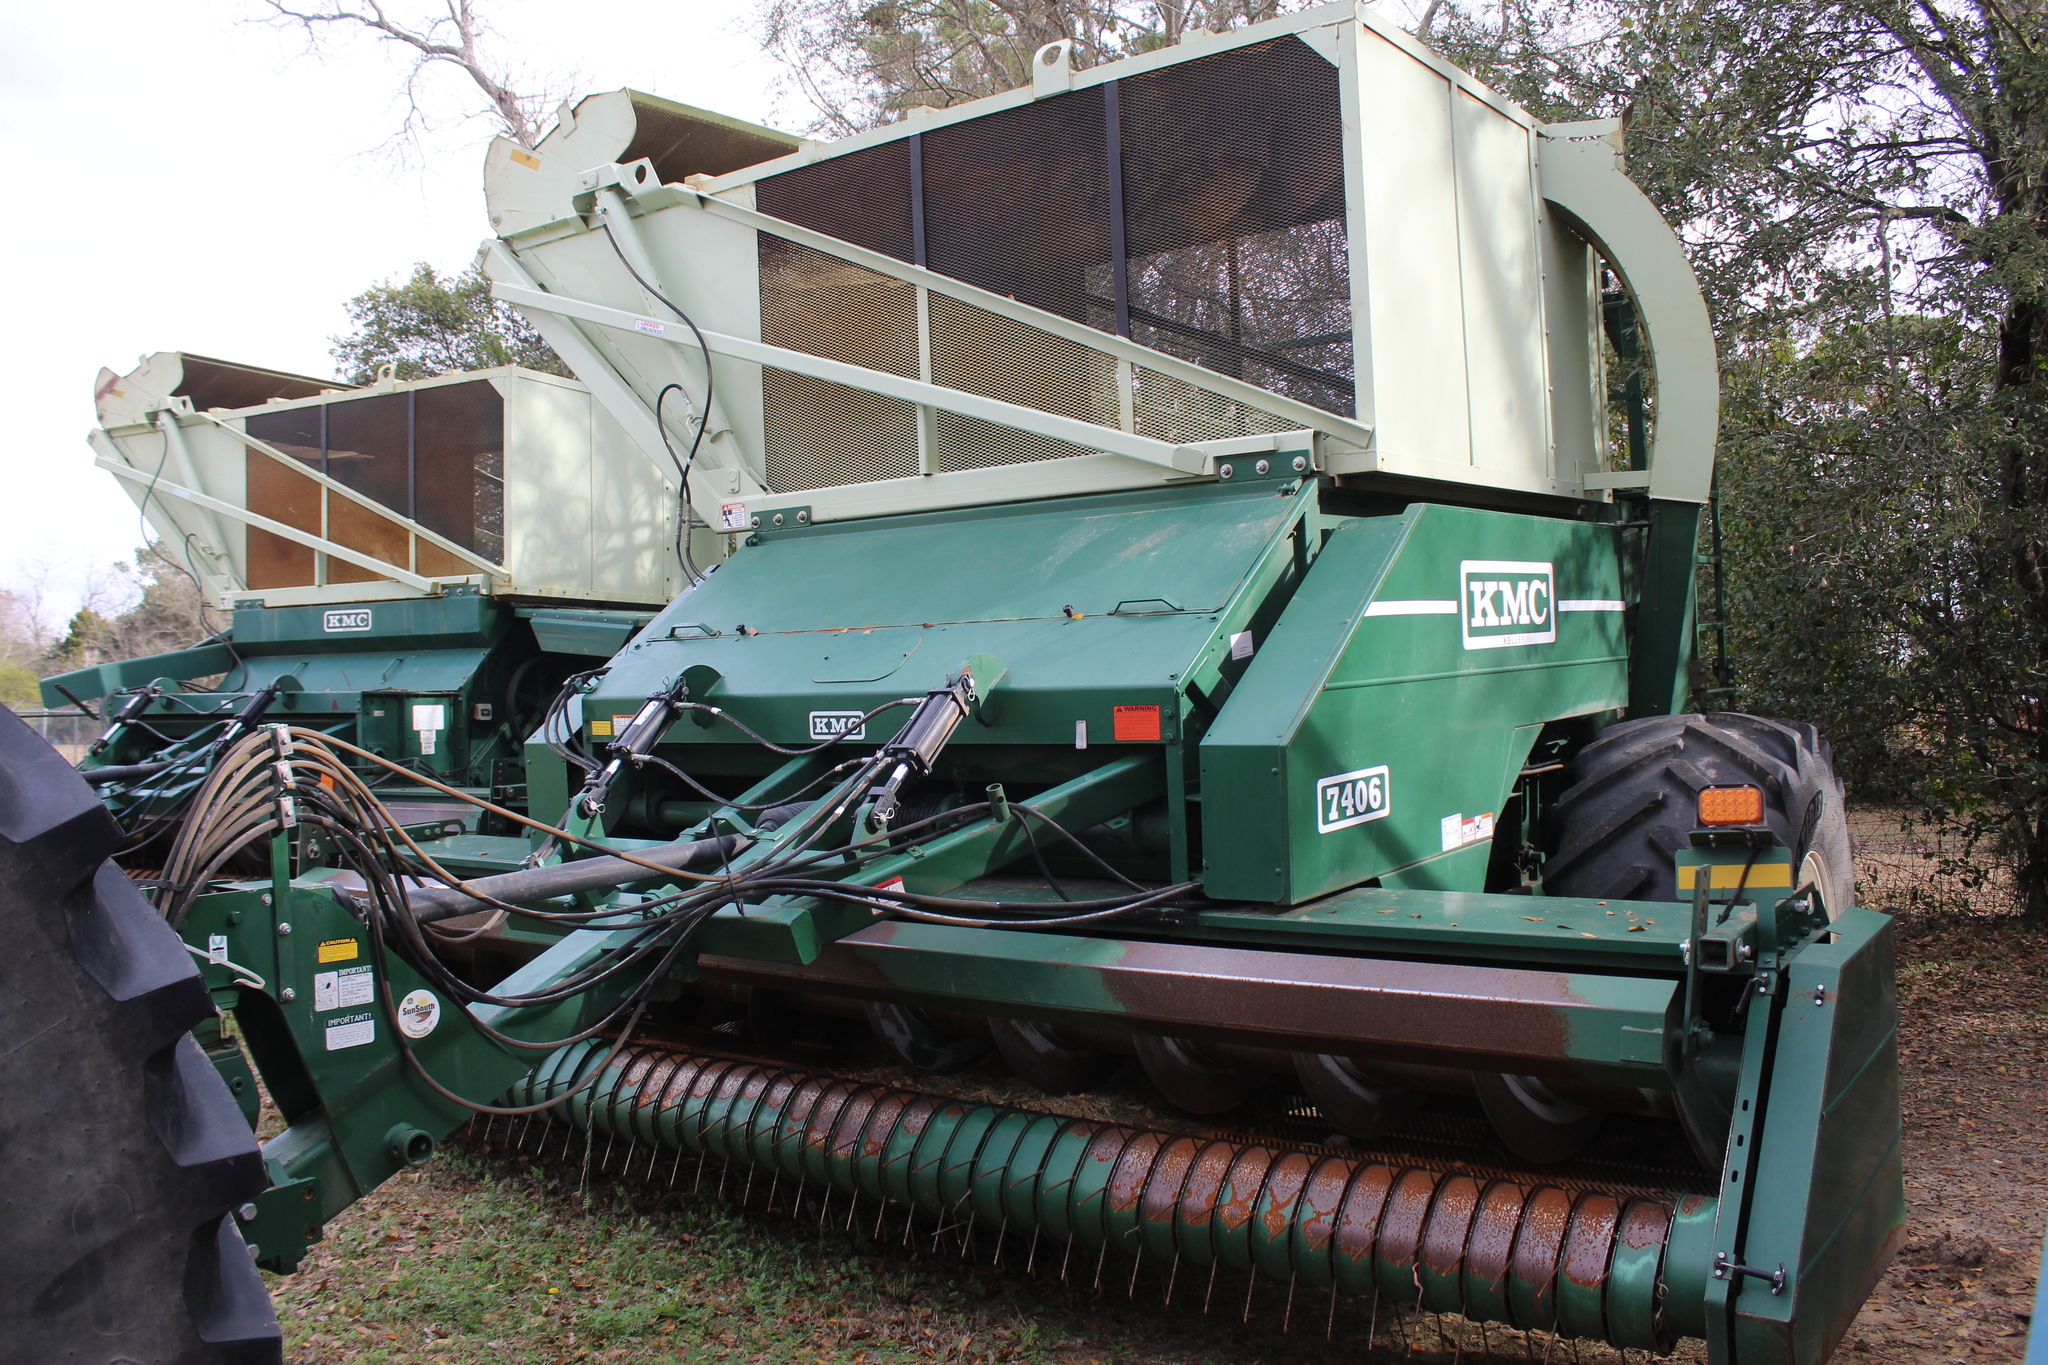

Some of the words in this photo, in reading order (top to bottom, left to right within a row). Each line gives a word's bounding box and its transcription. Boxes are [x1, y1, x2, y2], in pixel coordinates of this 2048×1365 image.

[1470, 579, 1548, 627] KMC
[328, 613, 368, 627] KMC
[1503, 636, 1525, 645] KELLEY
[814, 717, 860, 734] KMC
[1326, 777, 1382, 822] 7406
[325, 938, 351, 946] CAUTION
[338, 965, 372, 977] IMPORTANT!
[402, 1002, 436, 1016] SunSouth
[327, 1012, 372, 1027] IMPORTANT!
